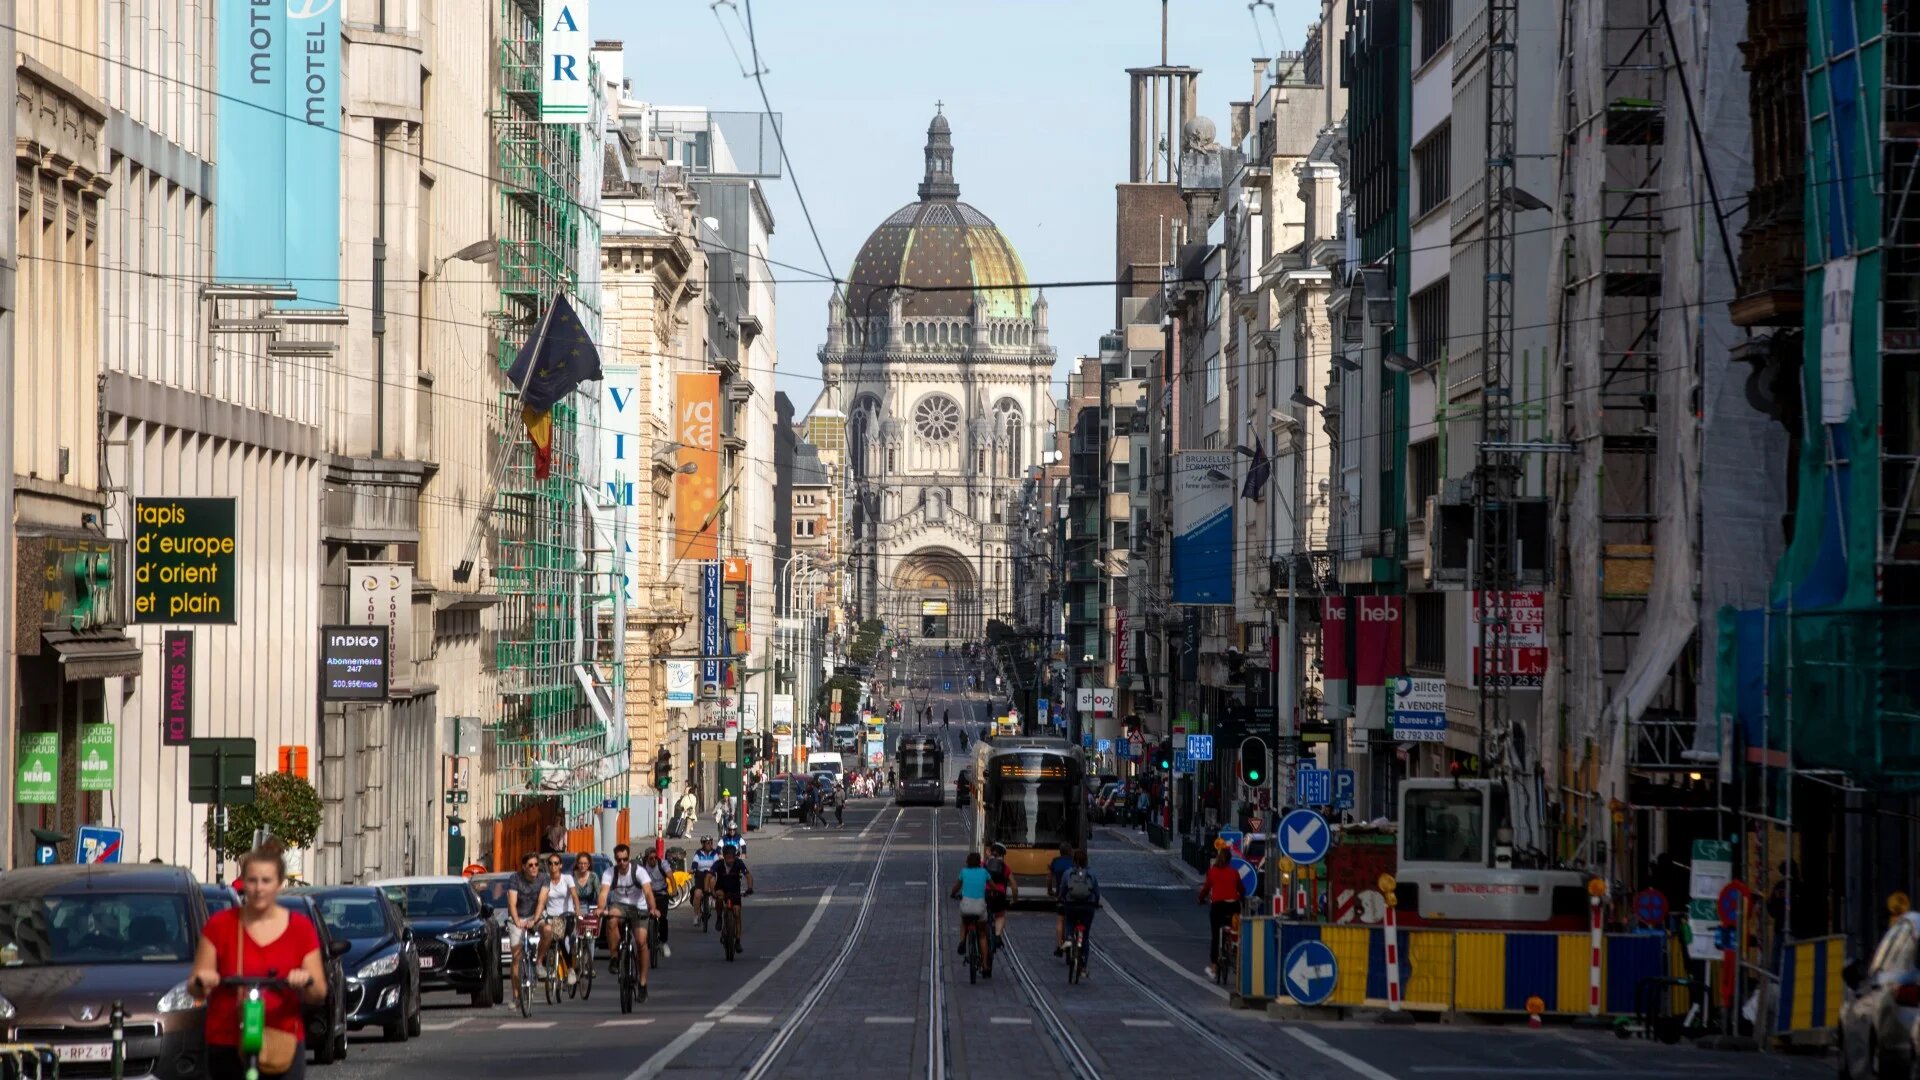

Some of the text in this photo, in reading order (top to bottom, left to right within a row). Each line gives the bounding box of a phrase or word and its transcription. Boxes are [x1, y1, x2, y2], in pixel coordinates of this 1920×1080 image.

[1185, 455, 1231, 463] BRUXELLES
[1185, 463, 1231, 471] FORMATION
[137, 503, 185, 528] tapis
[136, 592, 221, 617] et plain
[1510, 597, 1535, 607] rank
[1359, 596, 1399, 621] heb
[1509, 623, 1544, 634] LET
[331, 636, 379, 647] INDIGO
[327, 658, 383, 666] Abonnements
[170, 637, 186, 740] ICI PARIS XL
[1399, 701, 1444, 711] A VENDRE
[1399, 715, 1428, 725] Bureaux
[88, 735, 113, 744] HUUR
[1395, 731, 1406, 739] 02
[1408, 731, 1422, 740] 792
[1424, 731, 1434, 740] 92
[32, 745, 56, 755] HUUR
[23, 771, 52, 783] NMB
[1337, 774, 1352, 798] P
[42, 846, 53, 862] P
